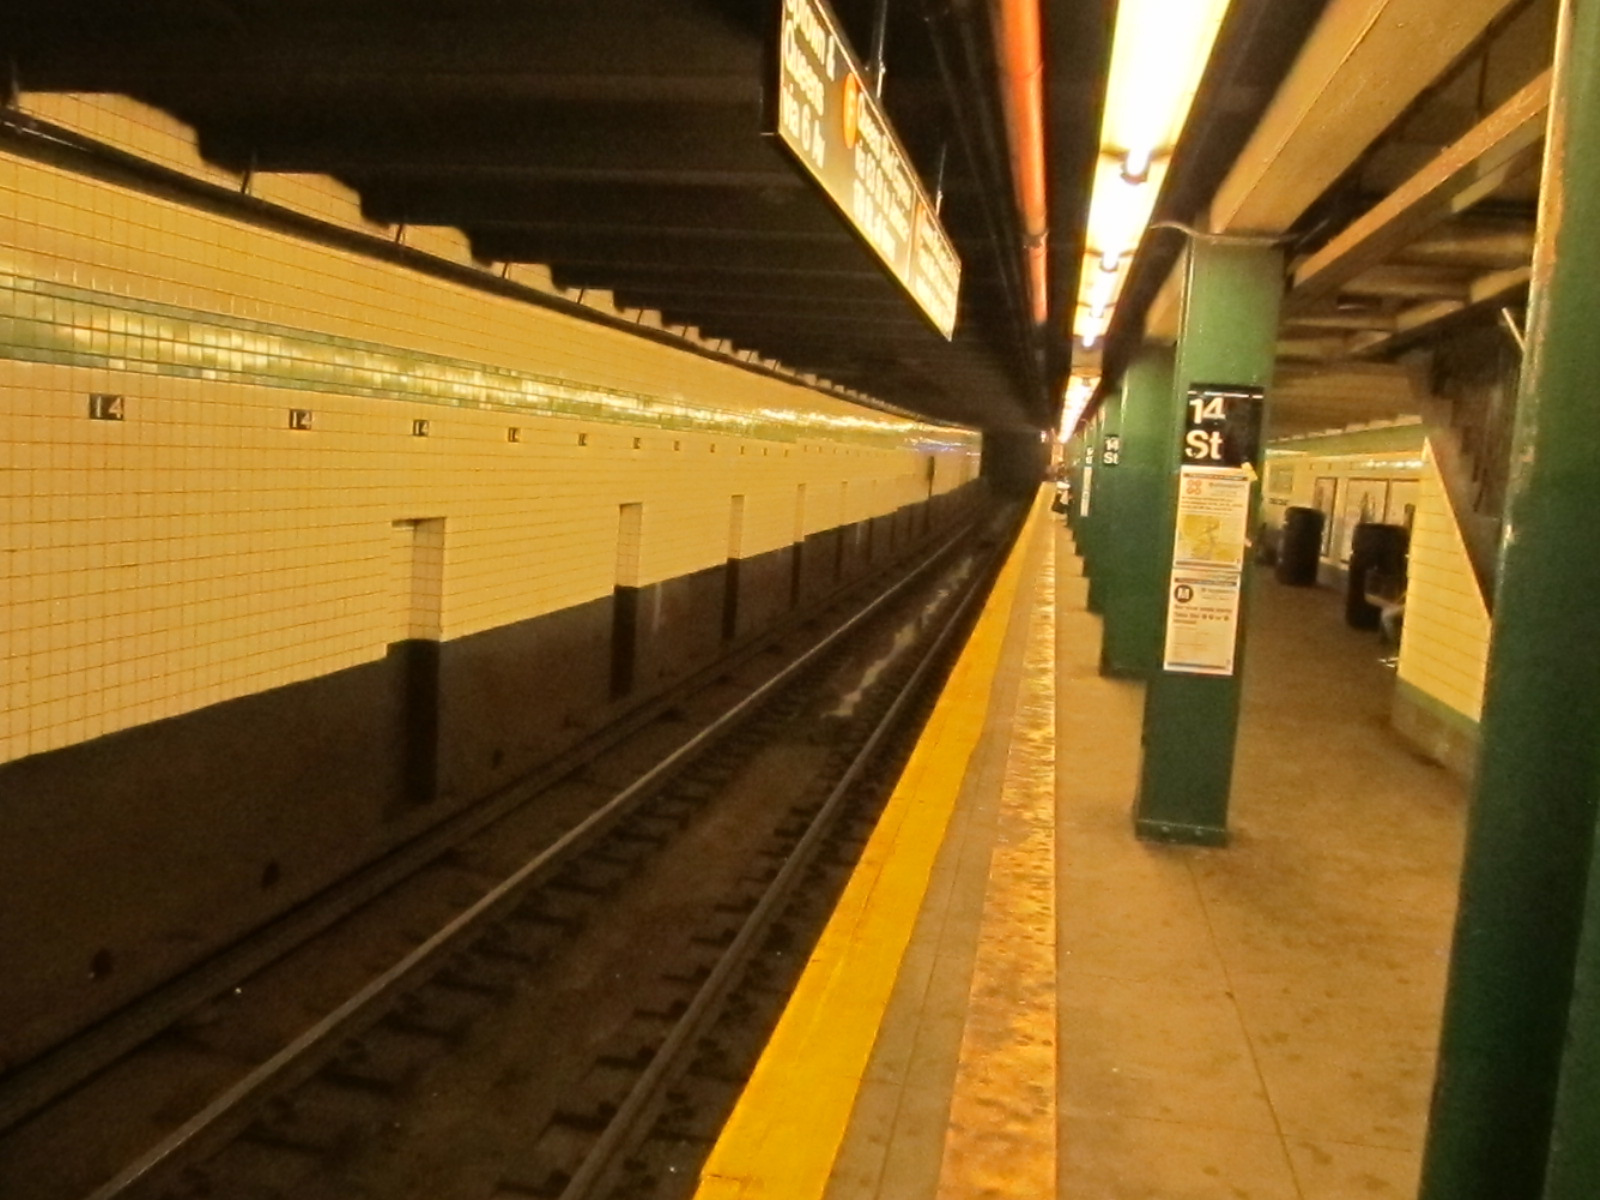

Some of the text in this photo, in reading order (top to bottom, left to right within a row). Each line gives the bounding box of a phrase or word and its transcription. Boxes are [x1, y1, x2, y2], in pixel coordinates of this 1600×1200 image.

[783, 19, 824, 117] Queens
[782, 82, 825, 169] via 6 Av
[92, 393, 125, 421] 14
[289, 408, 312, 430] 14
[1189, 397, 1226, 424] 14
[1103, 451, 1119, 464] St
[1185, 429, 1223, 460] St
